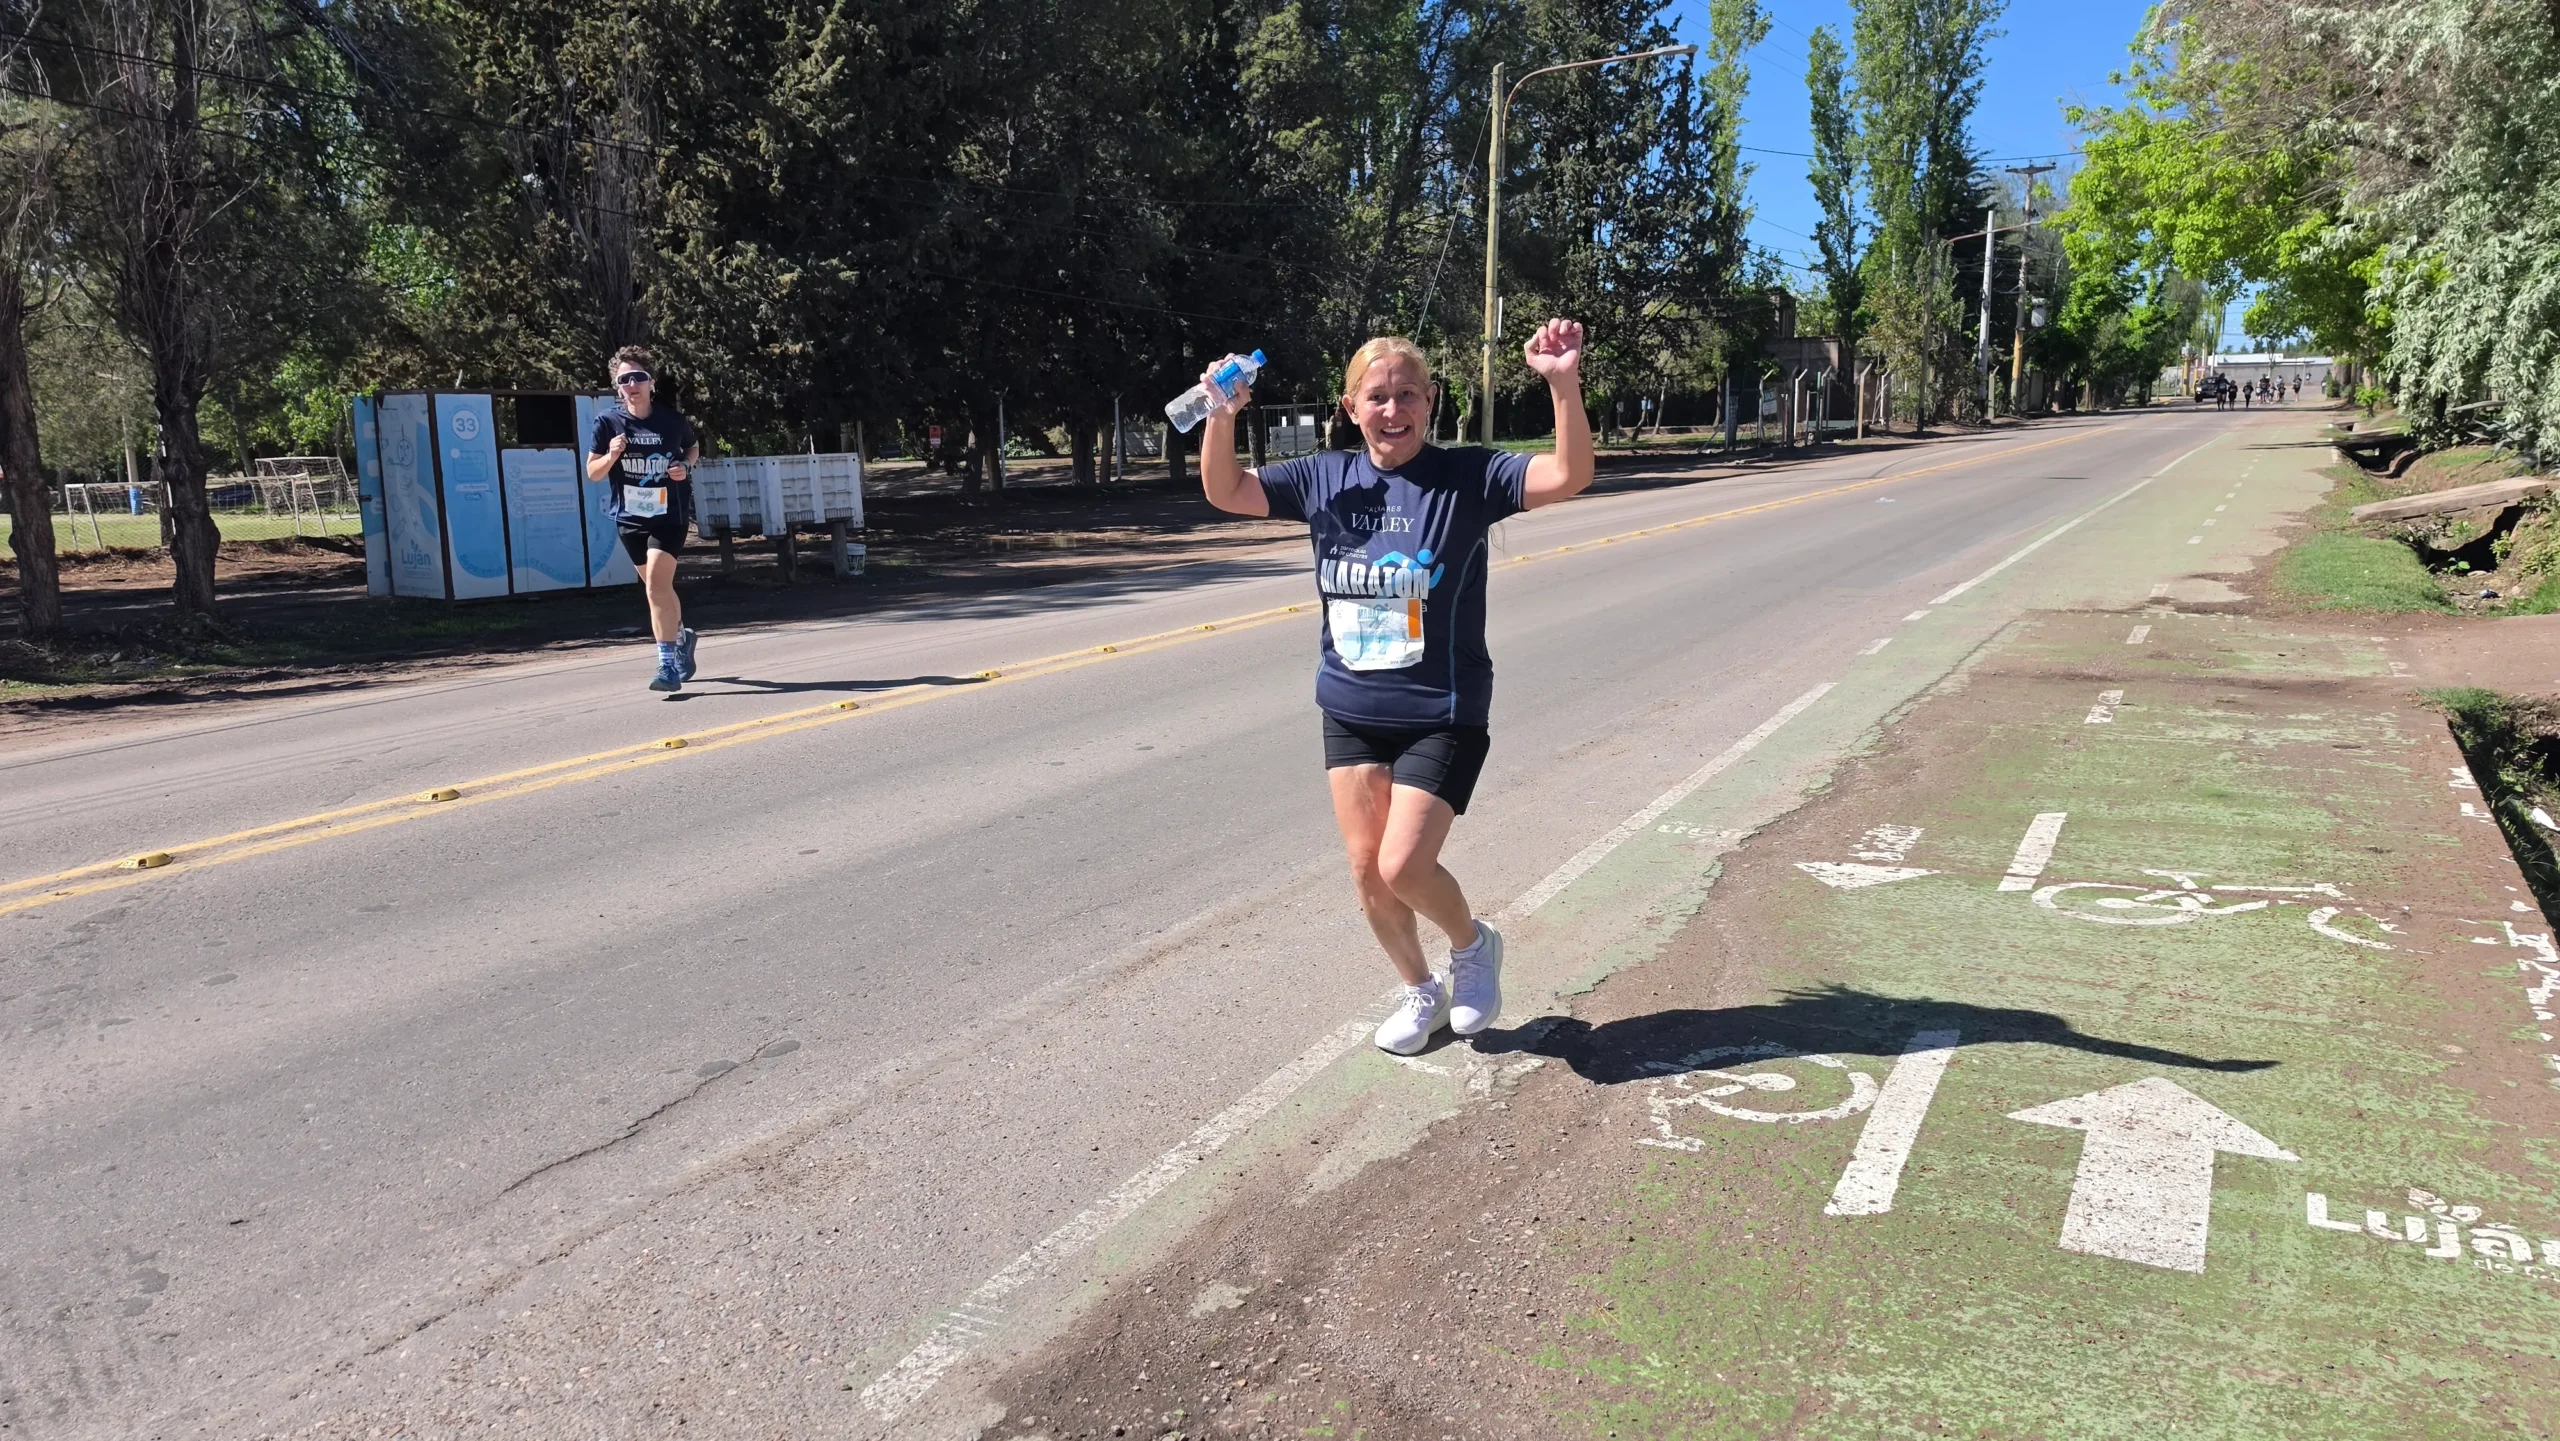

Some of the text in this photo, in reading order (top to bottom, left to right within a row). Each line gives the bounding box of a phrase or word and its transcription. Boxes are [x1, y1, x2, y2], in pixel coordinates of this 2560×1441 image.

[456, 418, 476, 432] 33
[628, 437, 663, 445] VALLEY
[637, 502, 654, 512] 48
[1351, 512, 1415, 533] VALLEY
[401, 548, 431, 569] Luján
[1321, 558, 1430, 600] MARATÓN
